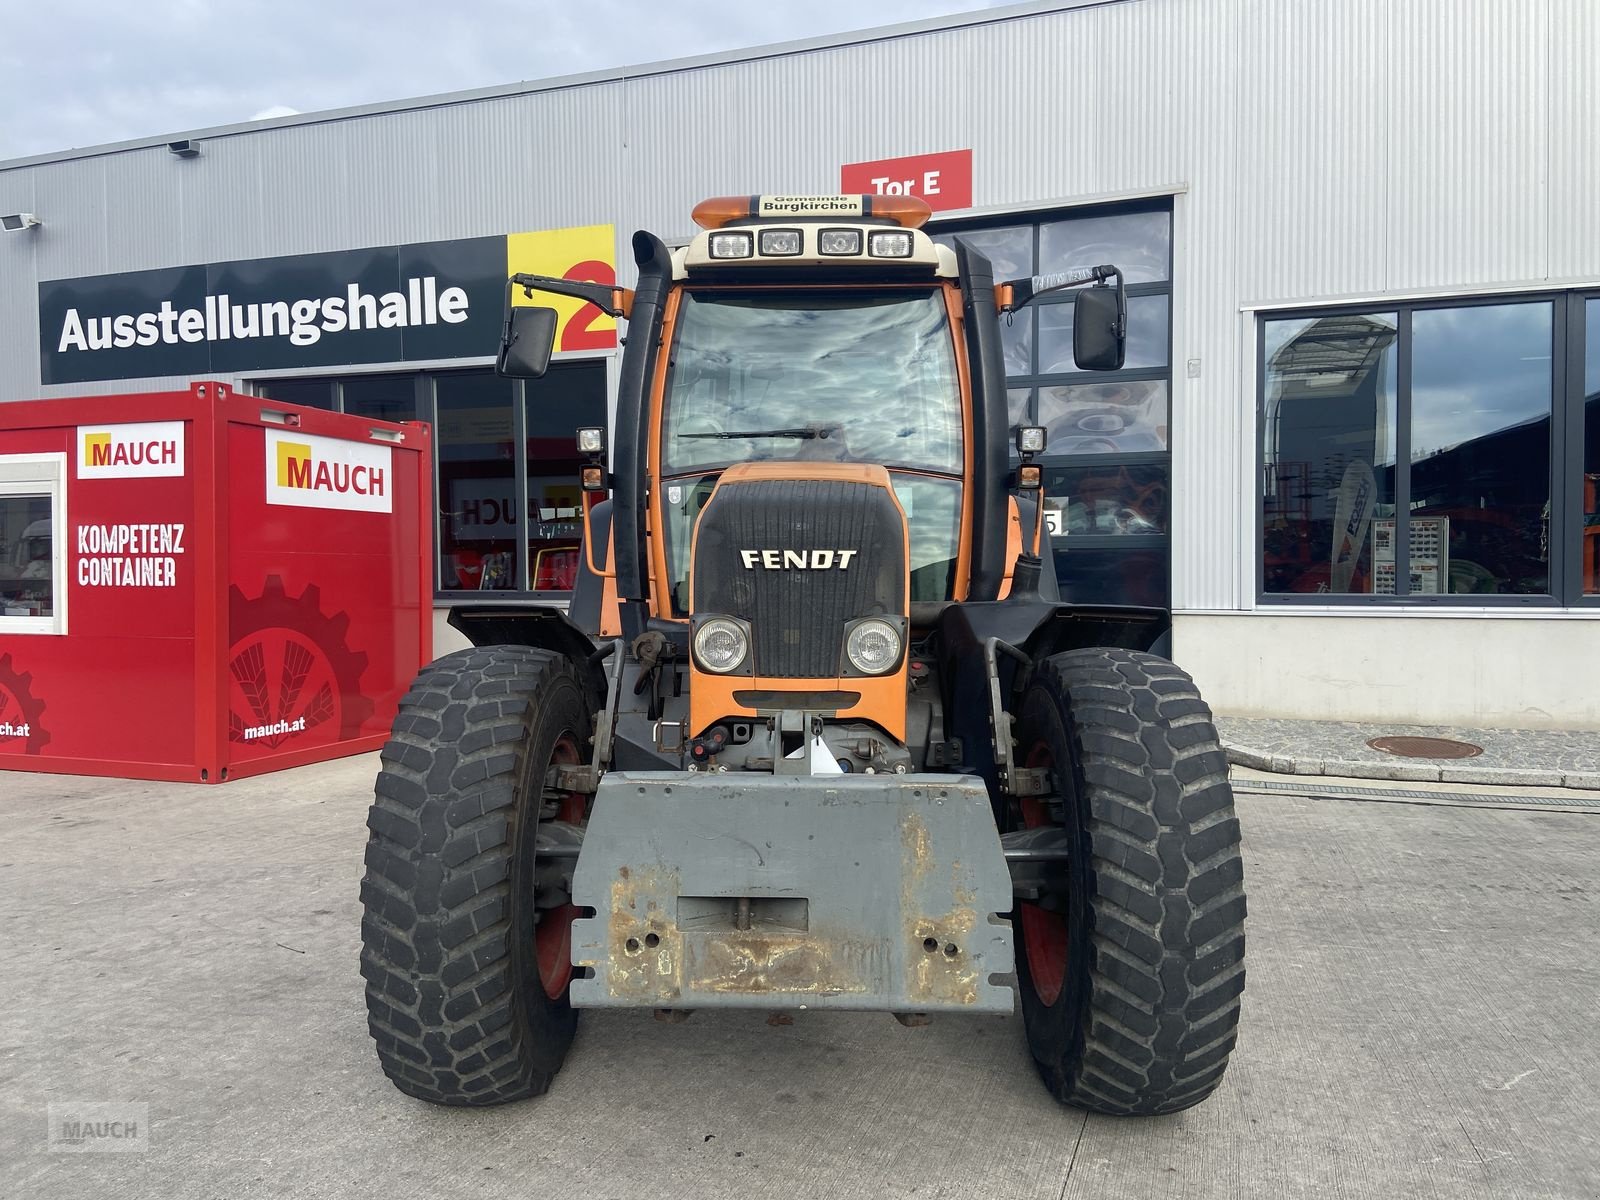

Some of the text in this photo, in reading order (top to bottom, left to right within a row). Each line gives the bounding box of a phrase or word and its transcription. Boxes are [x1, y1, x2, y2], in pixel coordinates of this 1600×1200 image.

[871, 171, 941, 196] Tor E
[763, 201, 858, 213] Burgkirchen
[58, 260, 617, 352] Ausstellungshalle 2
[92, 441, 176, 466] MAUCH
[287, 456, 384, 496] MAUCH
[78, 524, 185, 553] KOMPETENZ
[78, 557, 176, 587] CONTAINER
[740, 550, 857, 569] FENDT
[244, 716, 306, 740] mauch.at
